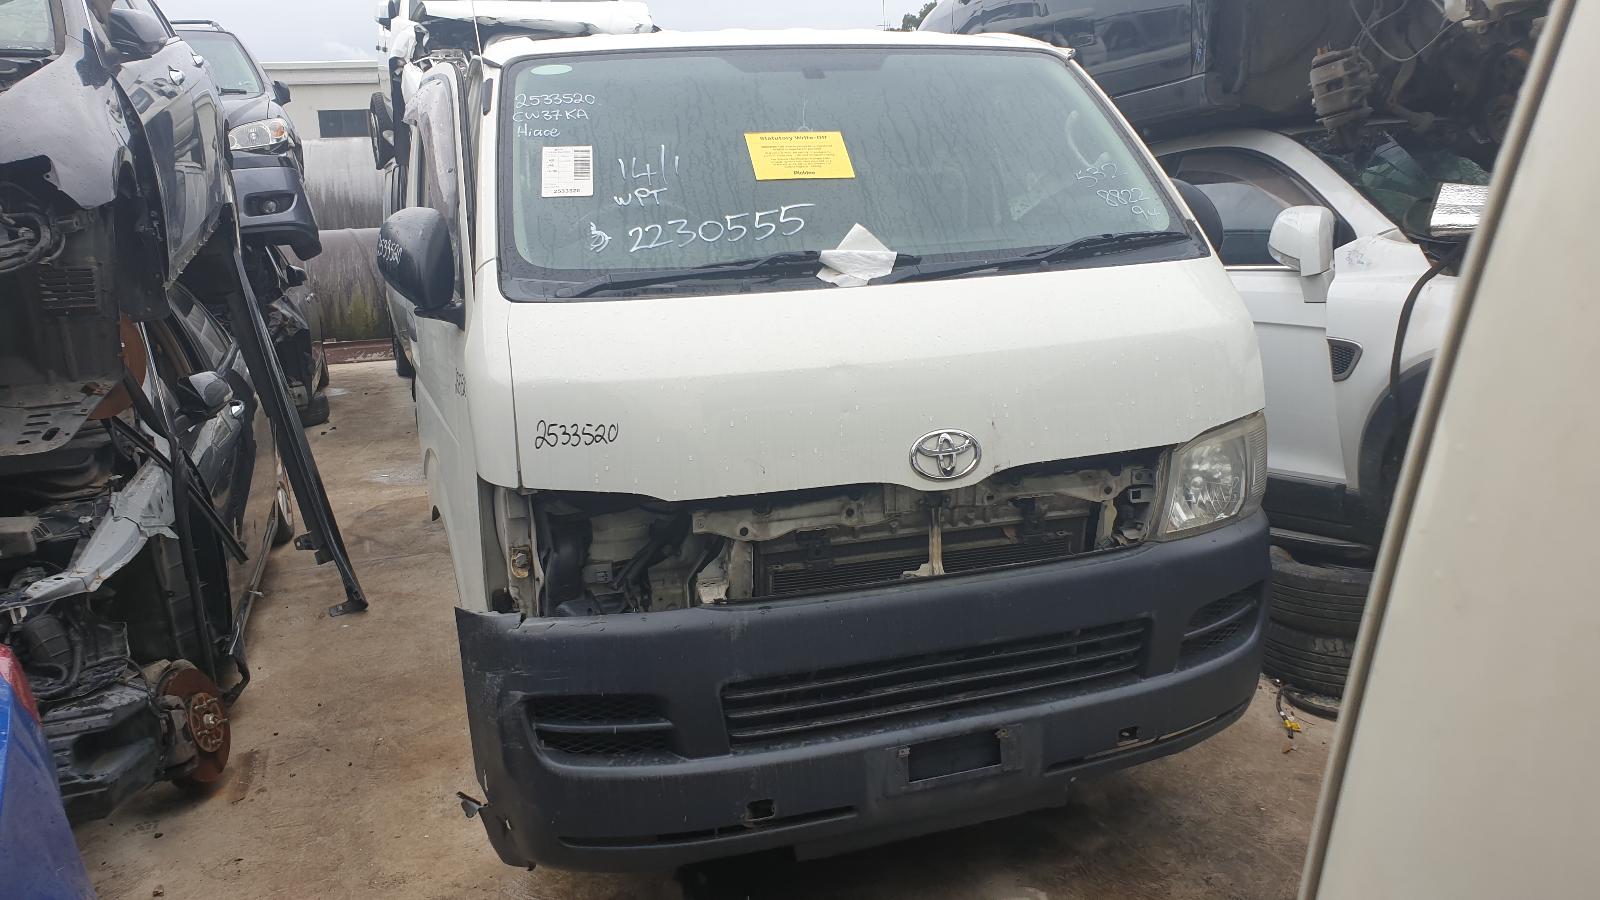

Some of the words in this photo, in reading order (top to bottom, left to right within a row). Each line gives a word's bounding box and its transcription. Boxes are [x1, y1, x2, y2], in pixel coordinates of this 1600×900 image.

[515, 93, 596, 109] 2533520
[628, 202, 817, 253] 2230555
[535, 419, 619, 450] 2533520
